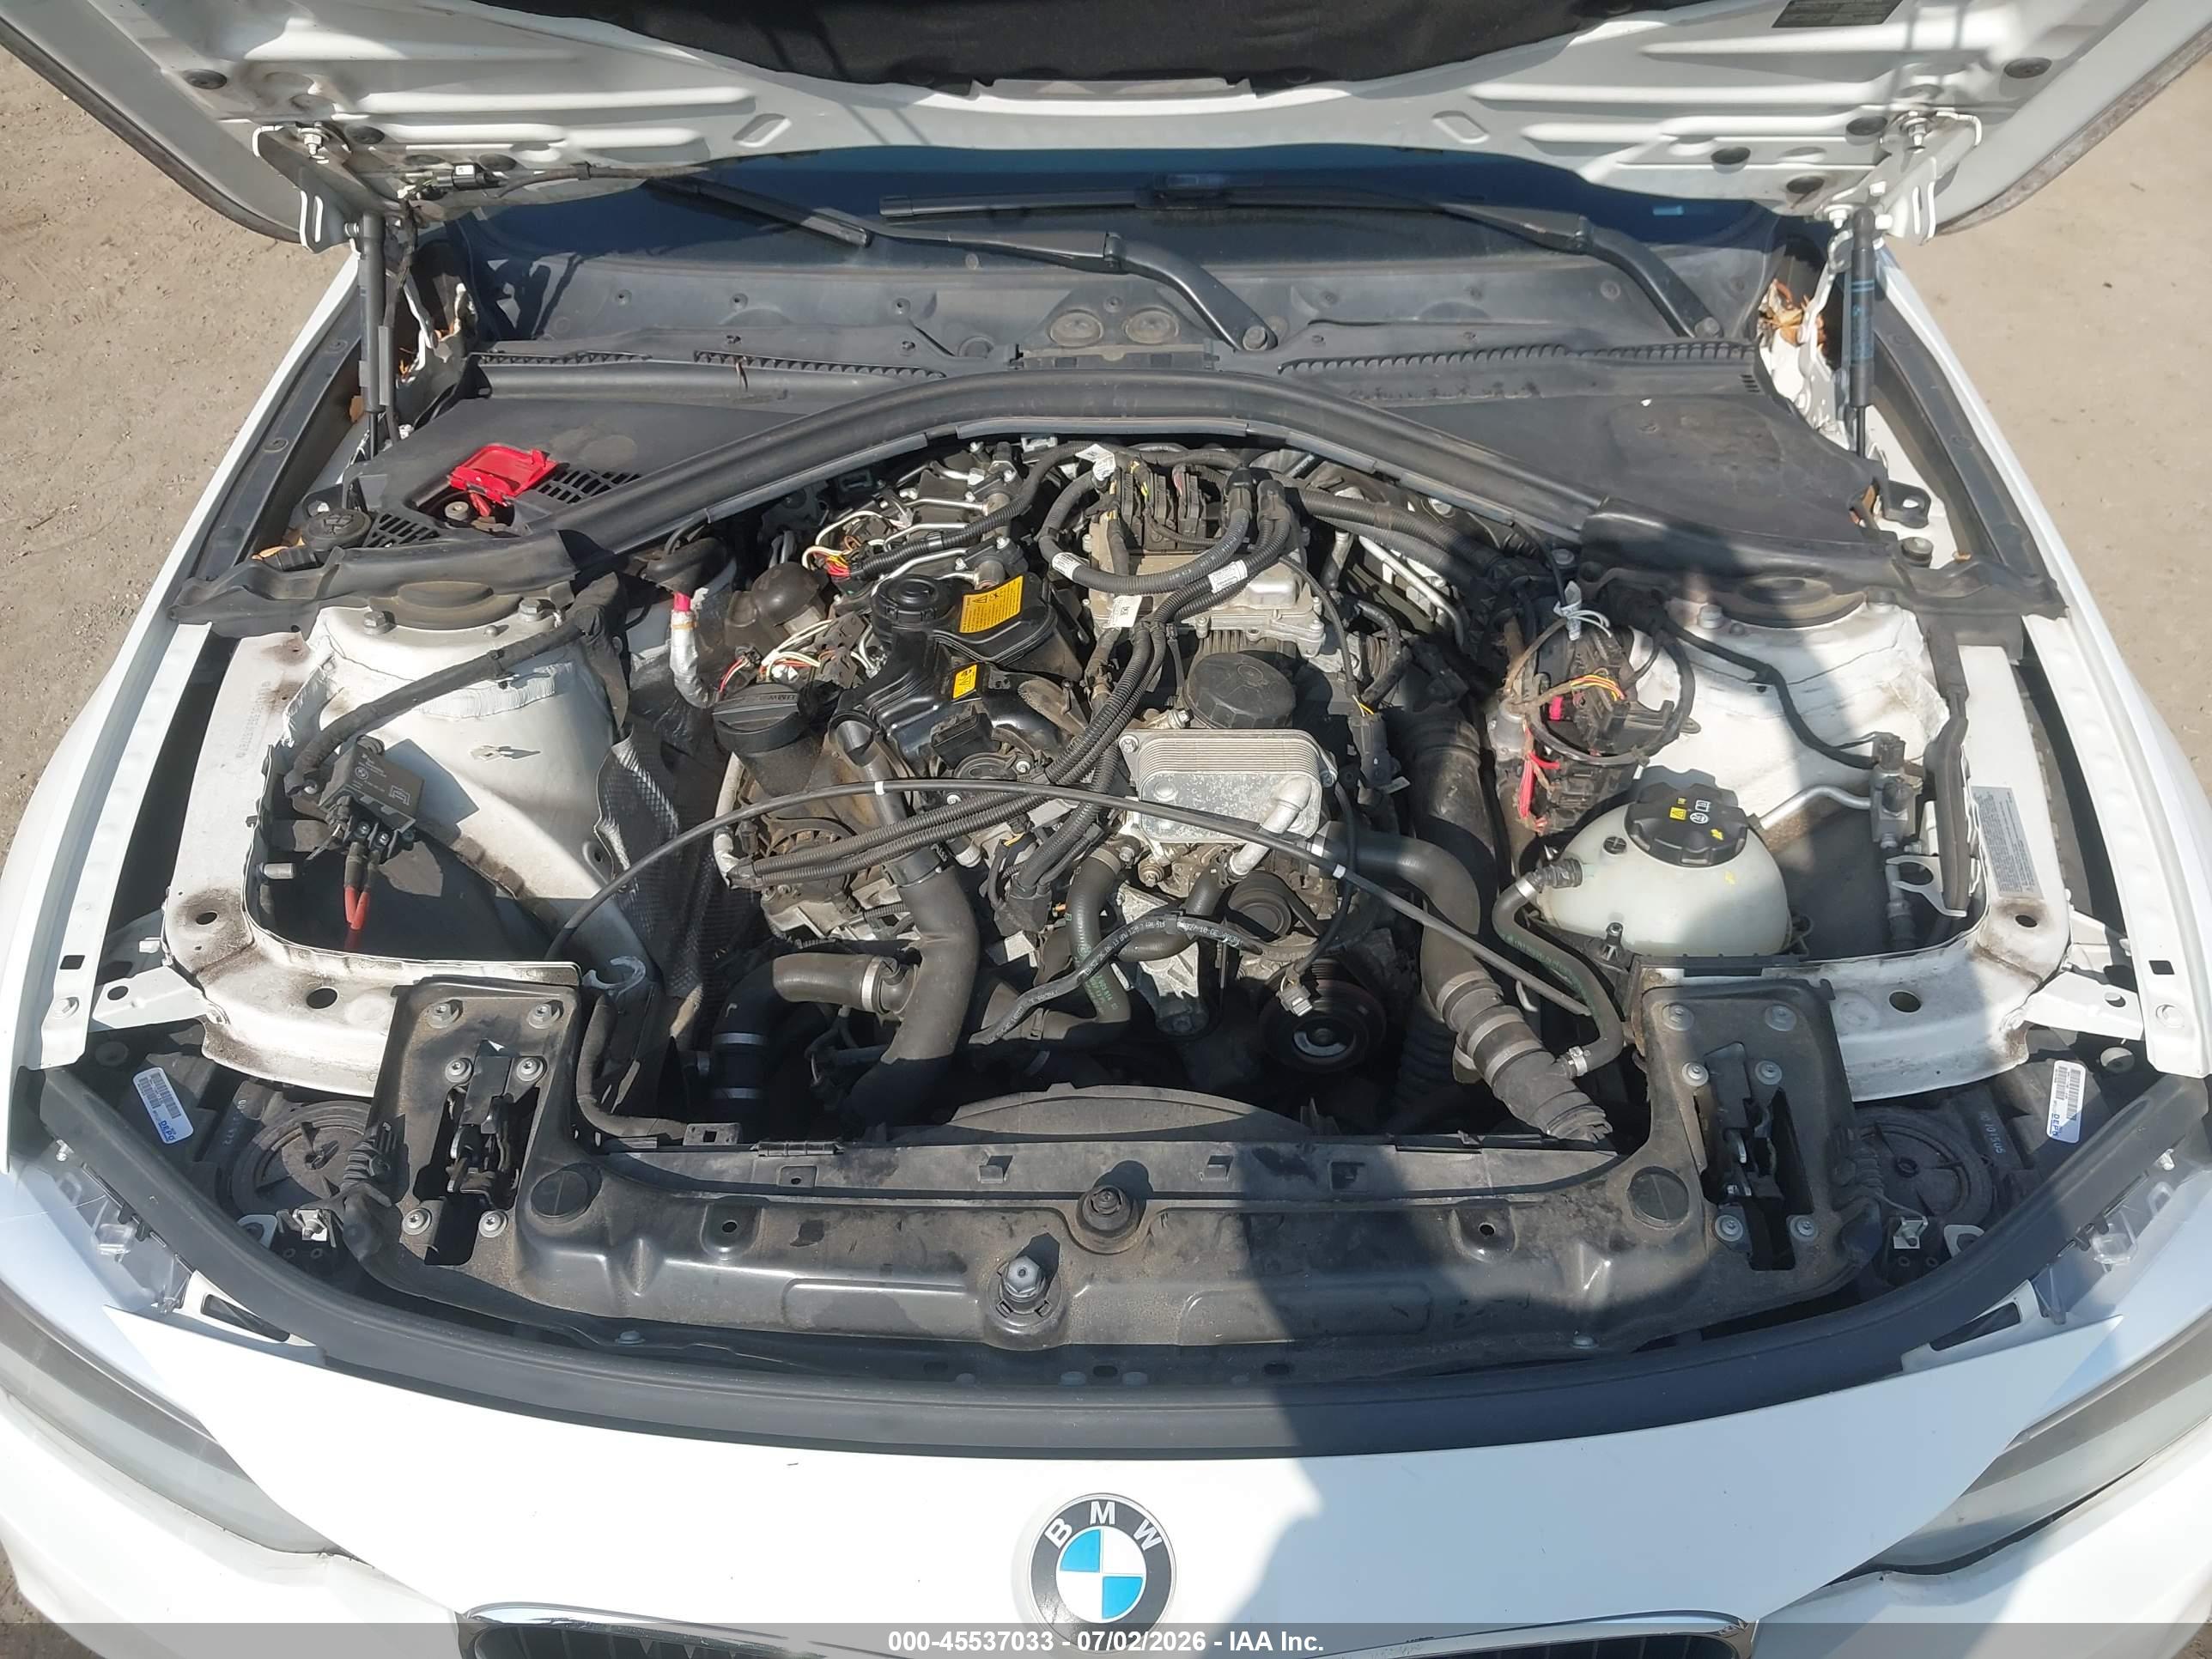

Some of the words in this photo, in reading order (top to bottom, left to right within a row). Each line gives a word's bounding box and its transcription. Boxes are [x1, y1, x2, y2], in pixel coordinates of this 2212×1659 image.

[160, 1120, 175, 1141] DEPO
[2051, 1113, 2060, 1136] DEPO
[1044, 1501, 1163, 1551] BMW
